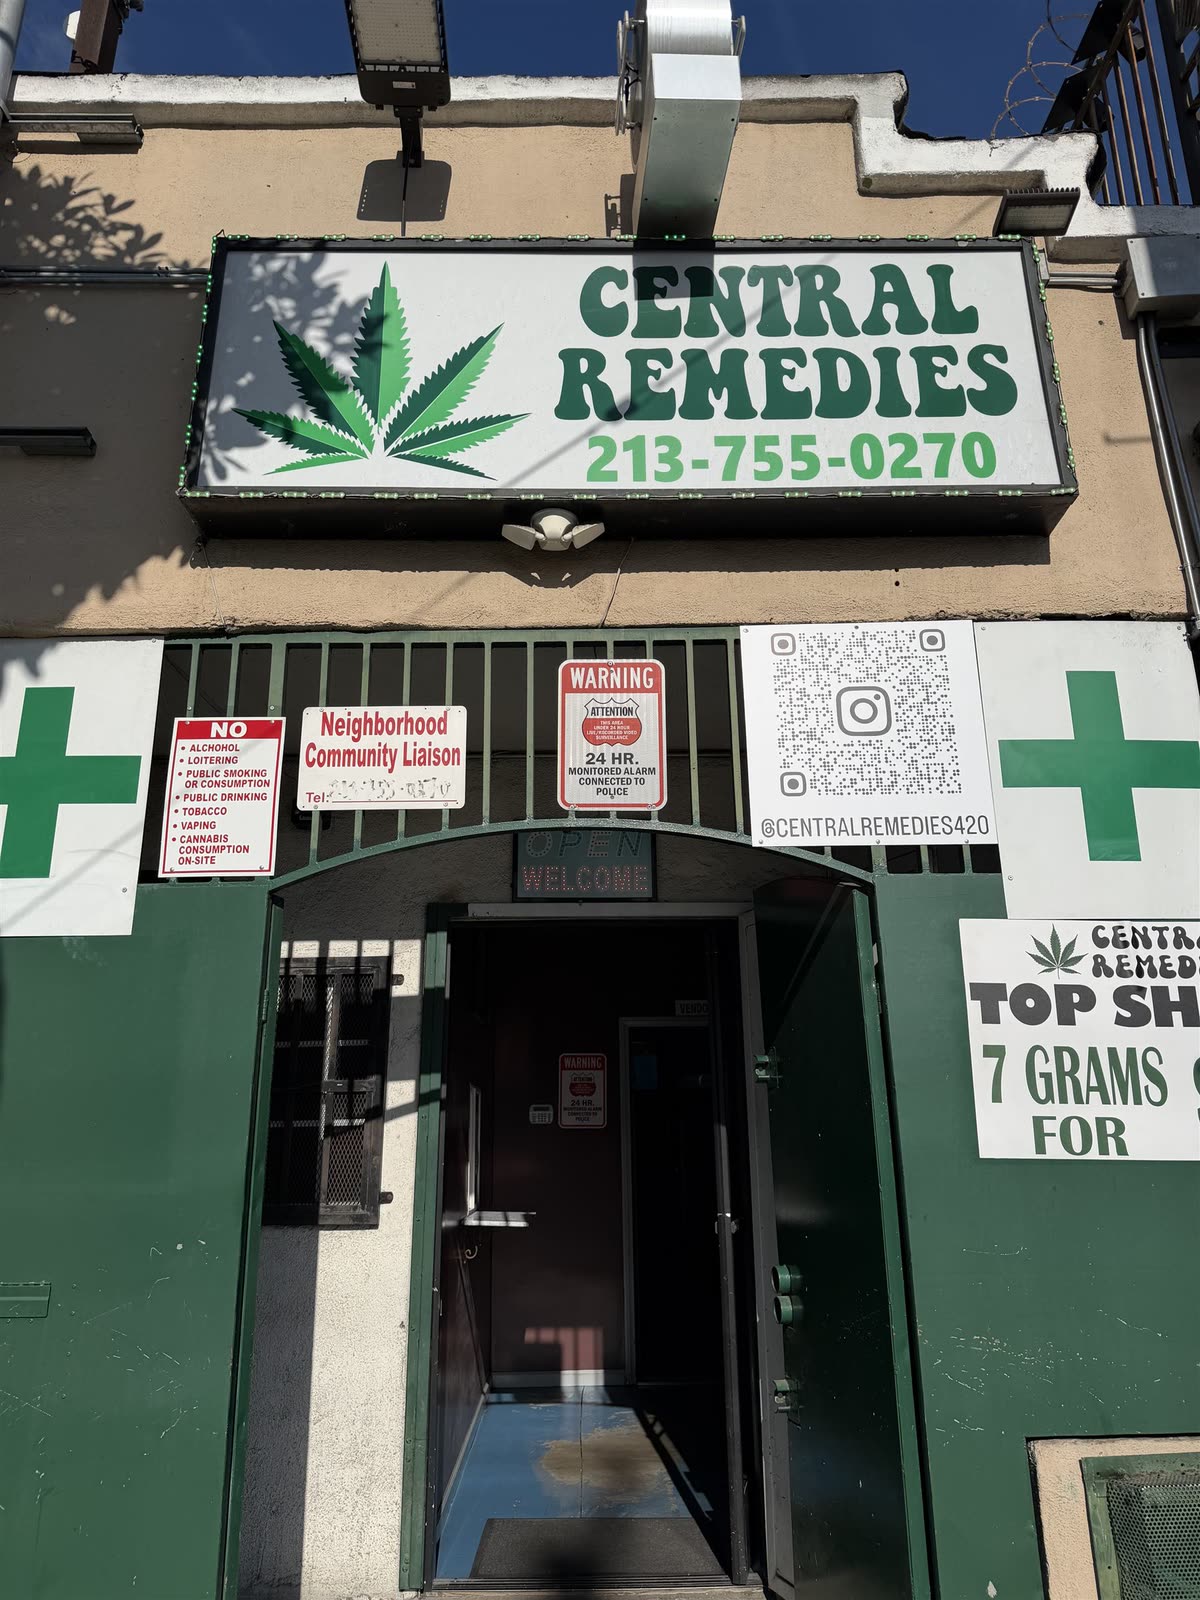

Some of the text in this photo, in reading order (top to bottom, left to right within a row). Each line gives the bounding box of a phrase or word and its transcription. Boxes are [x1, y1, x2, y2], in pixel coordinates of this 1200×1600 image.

[579, 263, 980, 338] CENTRAL
[554, 344, 1018, 421] REMEDIES
[586, 430, 996, 483] 213-755-0270
[570, 667, 654, 689] WARNING
[590, 706, 634, 717] ATTENTION
[210, 721, 248, 738] NO
[320, 711, 448, 743] Neighborhood
[189, 743, 240, 752] ALCHOHOL
[187, 756, 239, 765] LOITERING
[305, 741, 461, 774] Community Liaison
[585, 752, 639, 765] 24 HR.
[186, 769, 267, 778] PUBLIC SMOKING
[568, 767, 656, 776] MONITORED ALARM
[184, 779, 271, 788] OR CONSUMPTION
[578, 777, 646, 786] CONNECTED TO
[183, 792, 268, 802] PUBLIC DRINKING
[596, 787, 629, 796] POLICE
[182, 807, 228, 816] TOBACCO
[180, 821, 217, 830] VAPING
[761, 815, 990, 838] @CENTRALREMEDIES420
[179, 834, 229, 844] CANNABIS
[526, 830, 642, 857] OPEN
[178, 845, 250, 854] CONSUMPTION
[177, 856, 216, 865] ON-SITE
[521, 865, 648, 892] WELCOME
[1091, 925, 1200, 950] CENTR
[1092, 954, 1200, 979] REMED
[969, 982, 1200, 1028] TOP SH
[564, 1056, 602, 1069] WARNING
[982, 1044, 1007, 1103] 7
[1025, 1044, 1169, 1107] GRAMS
[570, 1099, 595, 1107] 24 HR.
[1032, 1115, 1129, 1156] FOR
